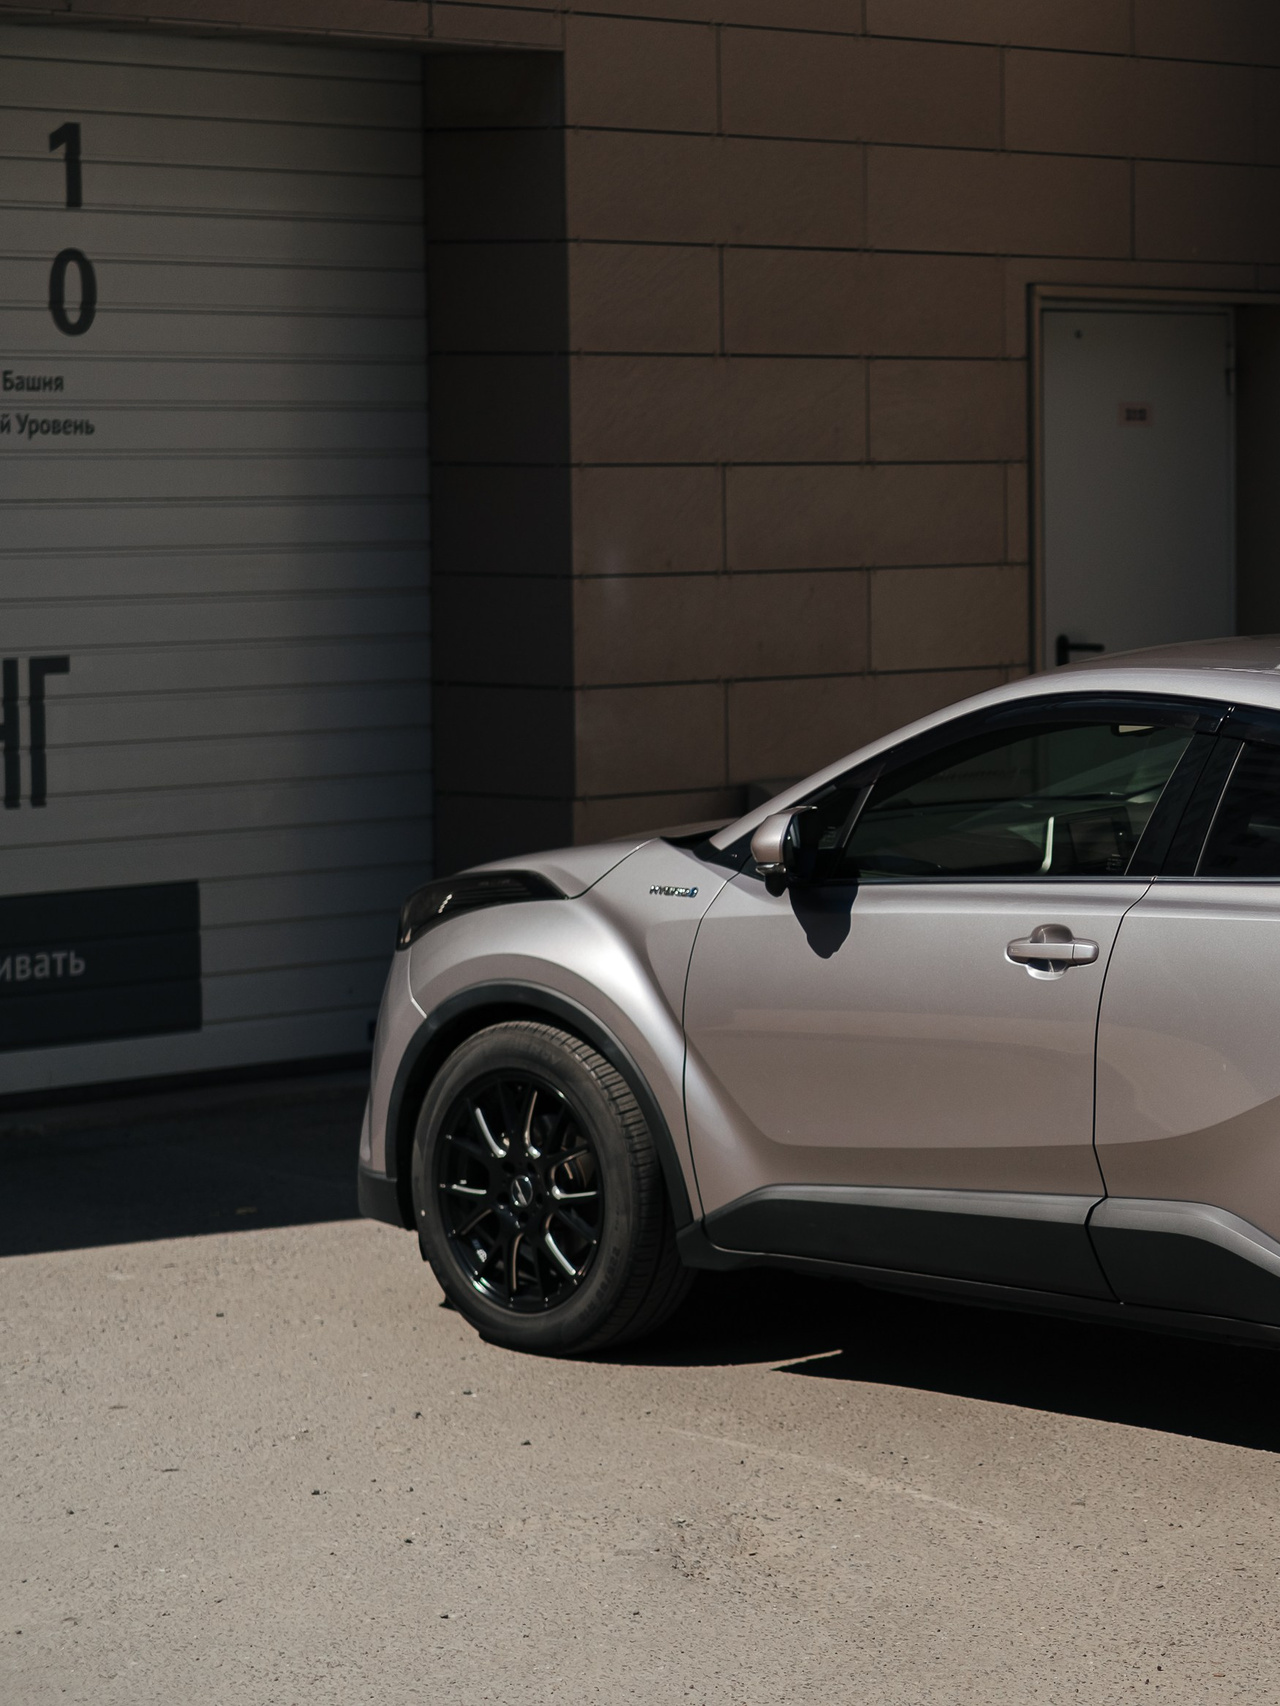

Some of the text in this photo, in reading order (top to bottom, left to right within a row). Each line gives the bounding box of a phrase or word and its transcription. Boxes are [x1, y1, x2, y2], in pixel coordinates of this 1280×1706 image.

[49, 122, 82, 208] 1
[48, 247, 97, 336] 0
[2, 370, 64, 392] Башня
[16, 413, 95, 440] Уровень
